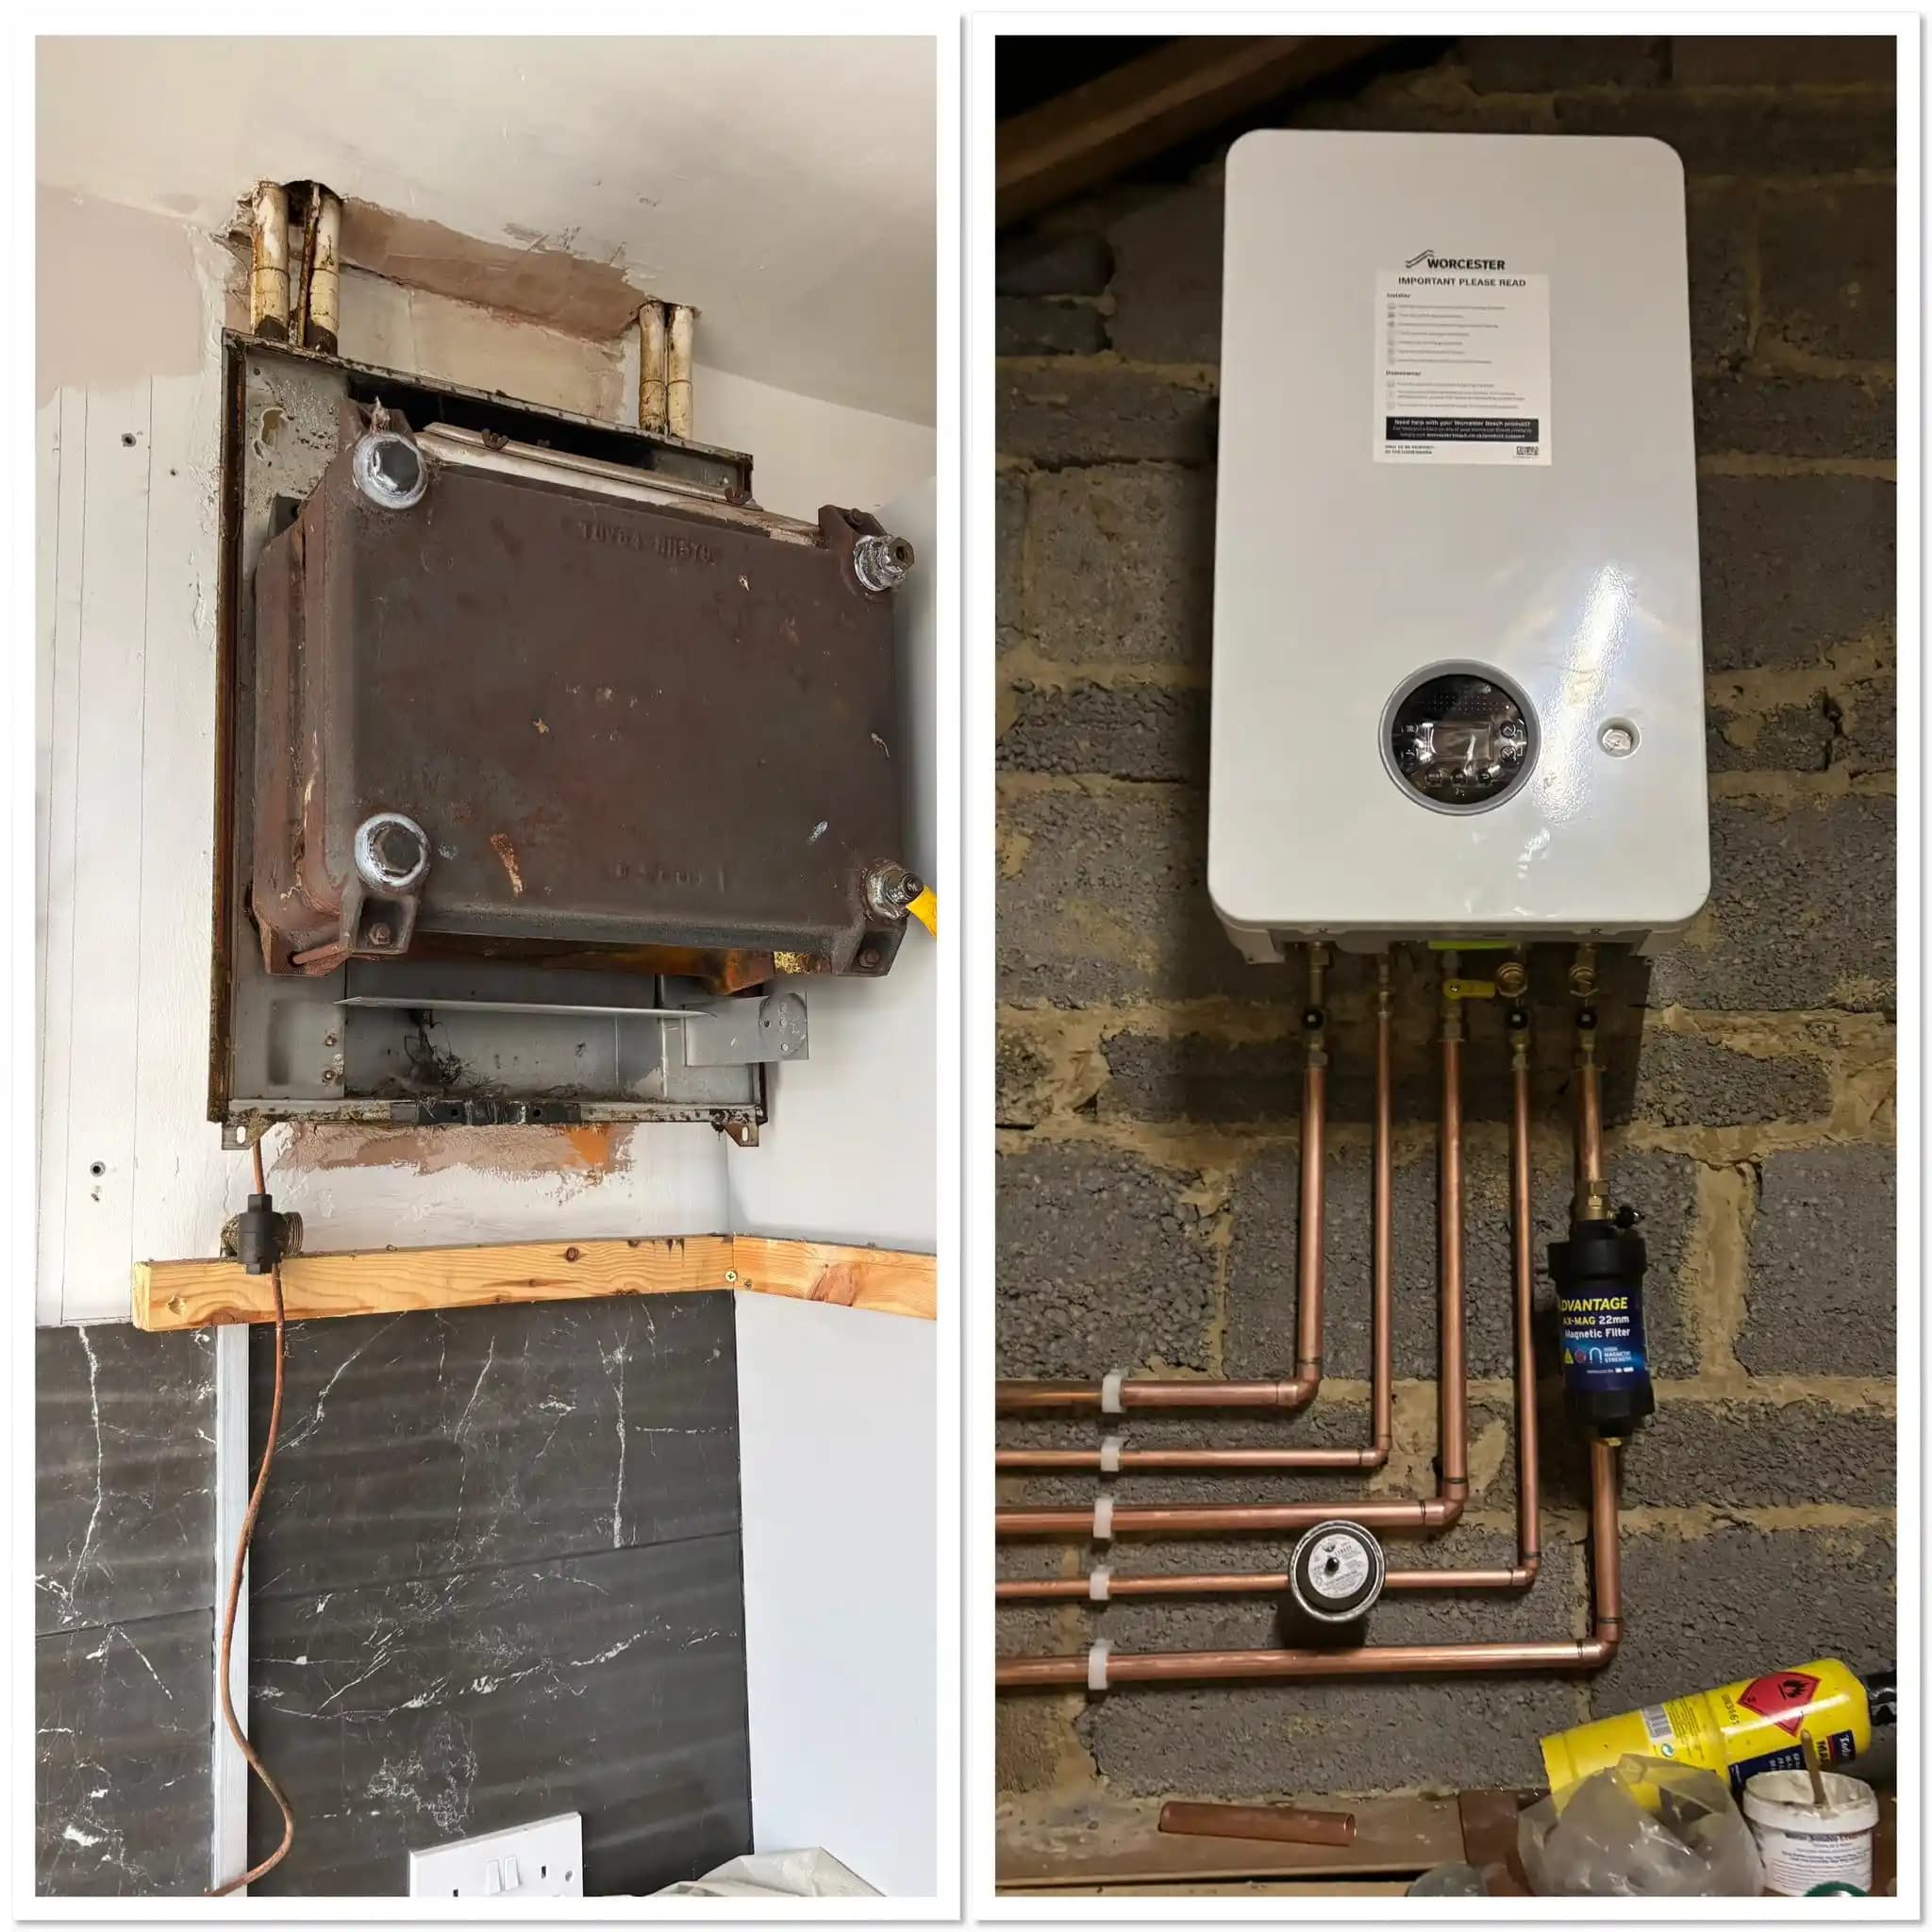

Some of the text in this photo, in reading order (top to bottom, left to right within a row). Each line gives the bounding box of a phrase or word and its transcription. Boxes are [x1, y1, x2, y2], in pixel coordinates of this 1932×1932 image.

[1427, 258, 1506, 271] WORCESTER
[1398, 276, 1526, 288] IMPORTANT PLEASE READ
[1561, 1297, 1628, 1311] DVANTAGE
[1598, 1315, 1630, 1324] 22mm
[1564, 1327, 1630, 1340] Magnetic Filter
